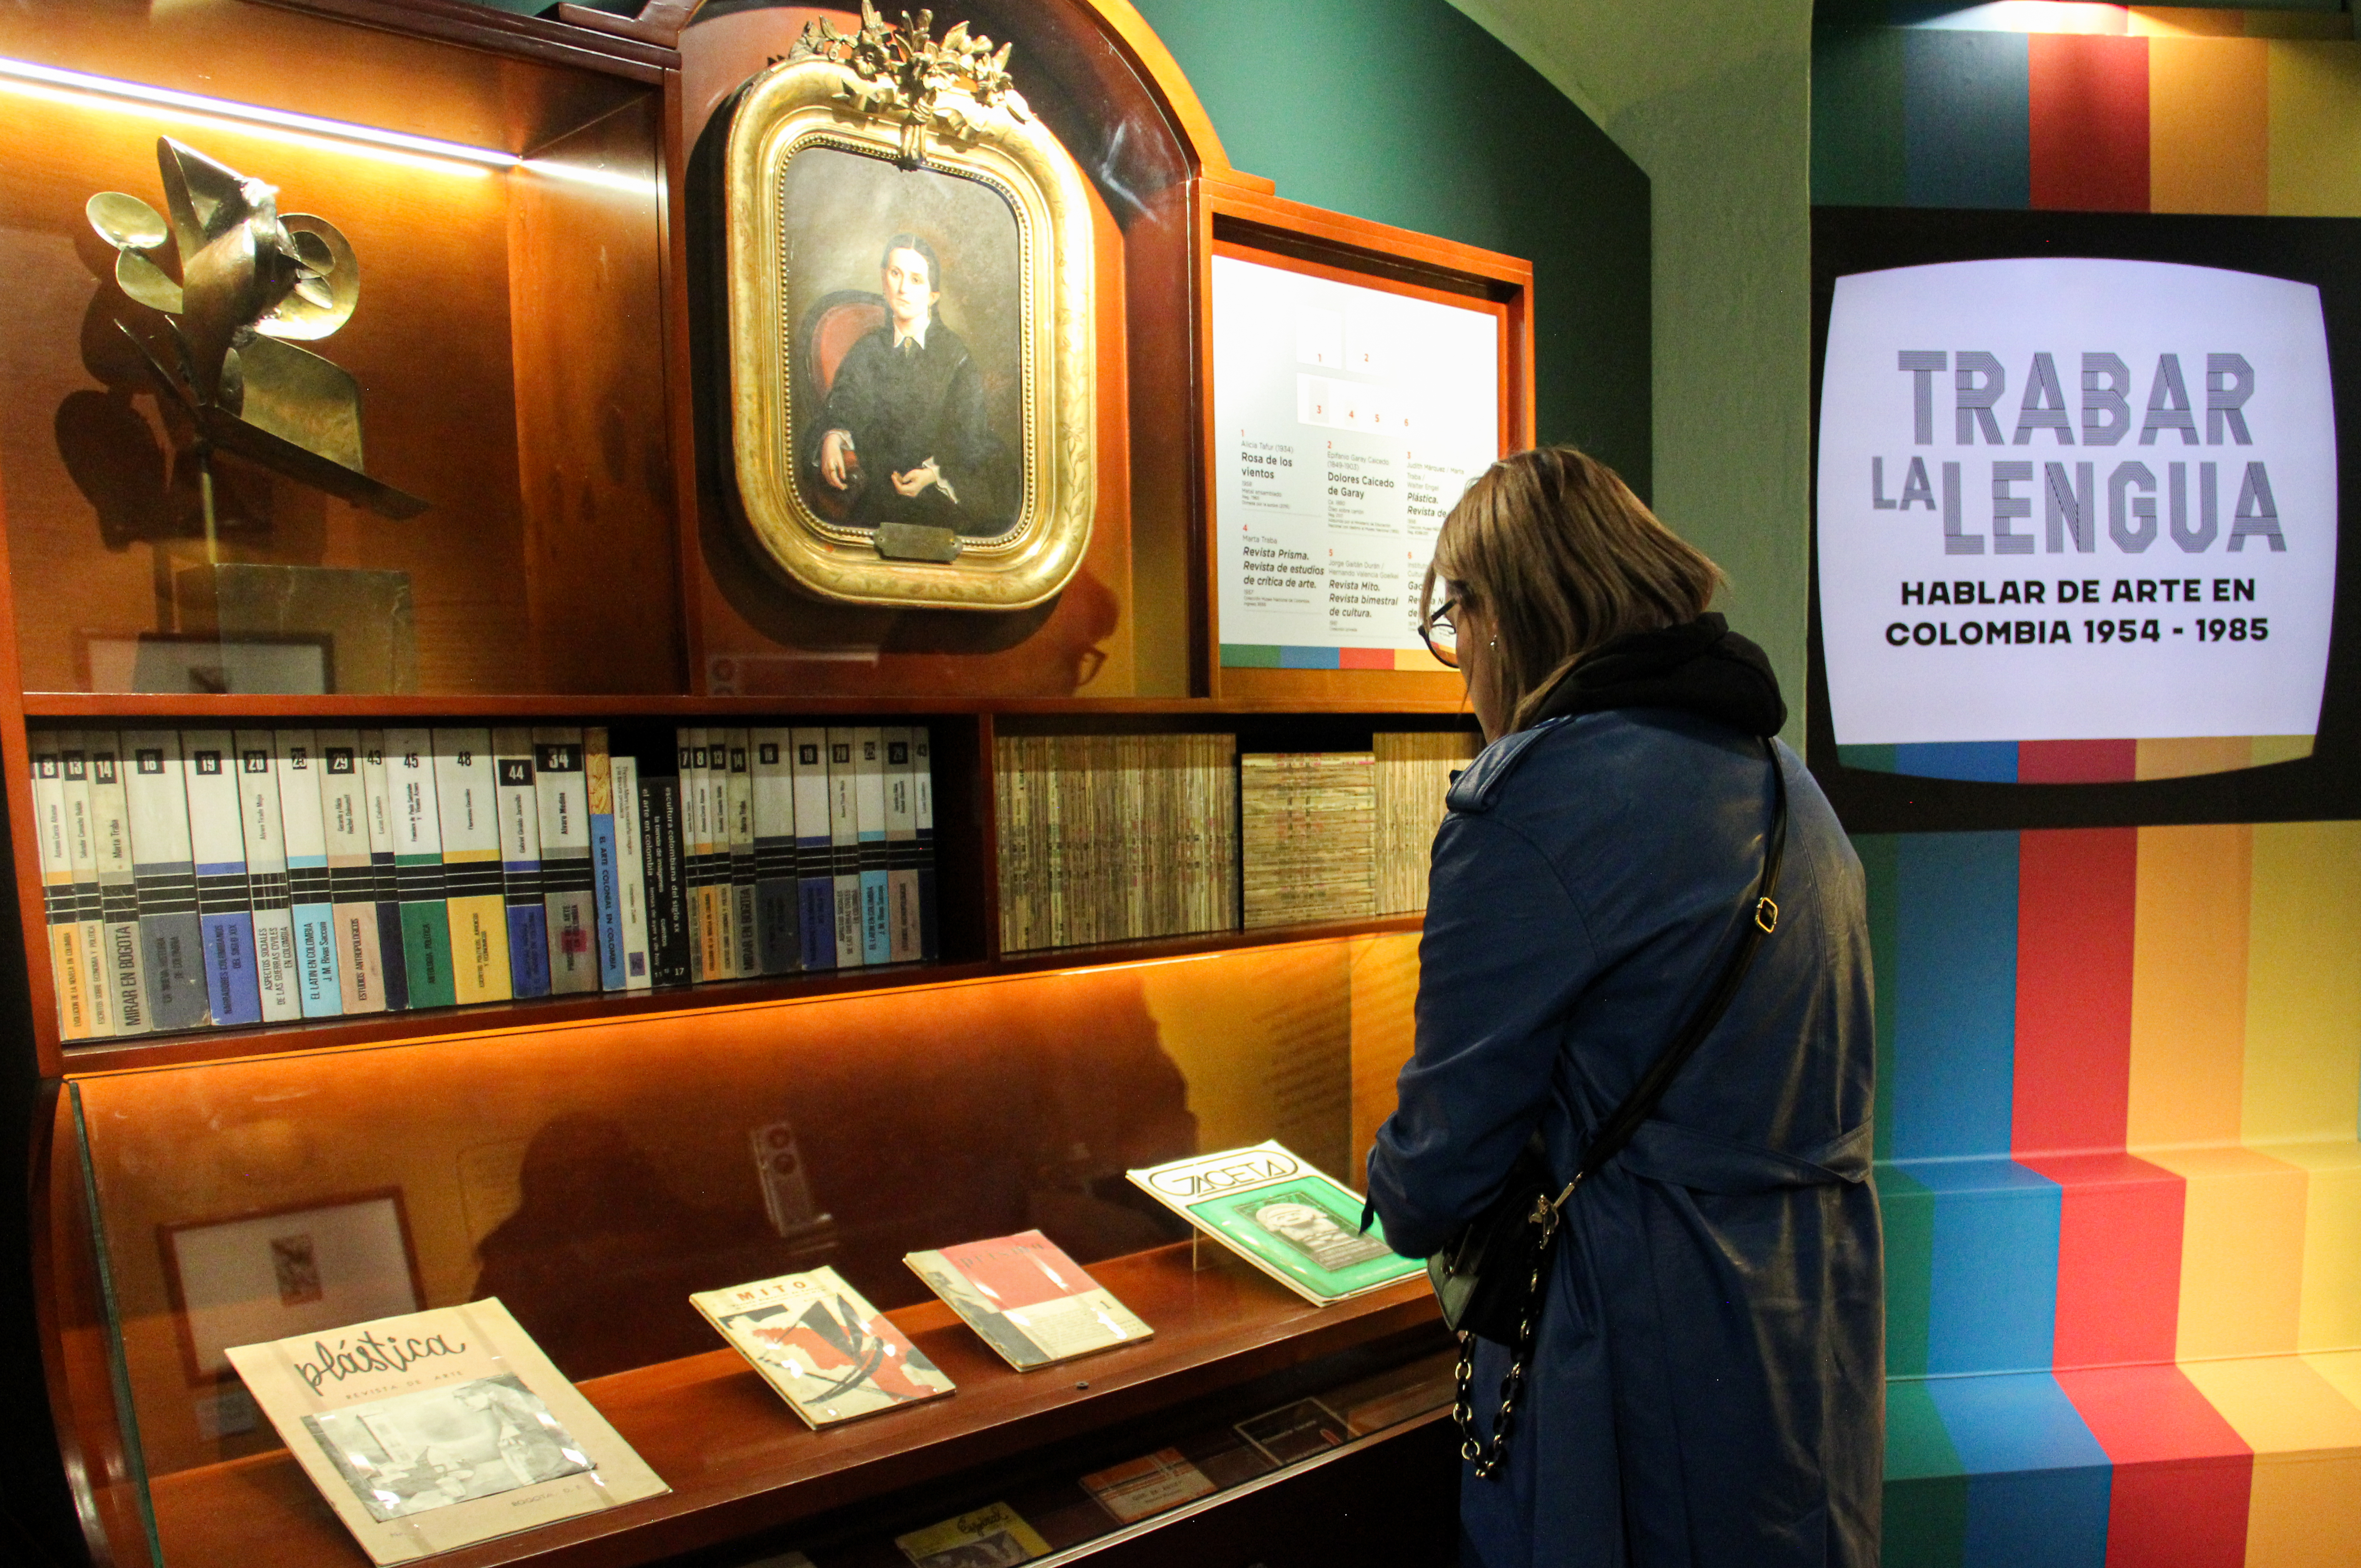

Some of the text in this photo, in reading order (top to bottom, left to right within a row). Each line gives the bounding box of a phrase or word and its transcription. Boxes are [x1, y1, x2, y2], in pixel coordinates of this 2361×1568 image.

[1364, 354, 1369, 362] 2
[1898, 351, 2254, 446] TRABAR
[1316, 405, 1321, 414] 3
[1349, 410, 1354, 418] 4
[1259, 442, 1273, 450] Tafur
[1275, 444, 1293, 453] (1934)
[1242, 452, 1292, 467] Rosa de los
[1327, 451, 1389, 466] Epifanio Garay Caicedo
[1242, 468, 1274, 479] vientos
[1328, 472, 1394, 487] Dolores Caicedo
[1872, 456, 1936, 511] LA
[1328, 486, 1364, 500] de Garay
[1407, 492, 1438, 504] Plástica.
[1407, 506, 1446, 518] Revista de
[1943, 461, 2287, 555] LENGUA
[1243, 546, 1309, 560] Revista Prisma.
[1243, 561, 1324, 575] Revista de estudios
[1329, 559, 1344, 569] Jorge
[1346, 560, 1362, 569] Gaitán
[1244, 576, 1316, 589] de crítica de arte.
[1329, 580, 1380, 592] Revista Mito.
[1329, 594, 1359, 604] Revista
[1361, 595, 1398, 606] bimestral
[1901, 578, 2255, 605] HABLAR DE ARTE EN
[1330, 607, 1372, 618] de cultura.
[1408, 609, 1417, 617] de
[1886, 620, 2072, 646] COLOMBIA
[2084, 619, 2161, 643] 1954
[2196, 617, 2269, 641] 1985
[249, 753, 264, 771] 20
[333, 753, 348, 770] 29
[367, 750, 382, 765] 43
[404, 753, 418, 768] 45
[457, 751, 471, 766] 48
[548, 748, 569, 769] 34
[697, 751, 704, 765] 8
[43, 758, 54, 776] 8
[97, 758, 112, 778] 14
[508, 765, 524, 780] 44
[642, 789, 650, 797] el
[559, 793, 567, 813] Medina
[643, 800, 651, 817] arte
[665, 787, 676, 828] escultura
[644, 821, 651, 831] en
[109, 819, 123, 858] Marta Traba
[654, 825, 663, 846] tienda
[644, 834, 654, 876] colombia
[656, 848, 663, 857] de
[668, 830, 678, 882] colombiana
[602, 870, 611, 910] COLONIAL
[670, 885, 679, 898] del
[670, 900, 680, 920] siglo
[606, 914, 613, 924] EN
[269, 927, 281, 951] CIVILES
[660, 919, 668, 947] cuentos
[280, 926, 292, 968] EN COLOMBIA
[320, 947, 330, 964] Rivas
[607, 927, 616, 970] COLOMBIA
[258, 927, 273, 991] ASPECTOS SOCIALES
[271, 953, 283, 981] GUERRAS
[304, 922, 320, 1000] EL LATIN EN COLOMBIA
[114, 926, 141, 1026] MIRAR EN BOGOTA
[675, 968, 684, 976] 17
[274, 983, 285, 995] LAS
[356, 972, 367, 1001] ESTUDIOS
[1171, 1158, 1287, 1198] GACETA
[960, 1244, 1044, 1268] prisma
[737, 1281, 806, 1301] MITO
[1099, 1301, 1112, 1310] 1
[294, 1331, 466, 1397] plástica
[346, 1386, 398, 1399] REVISTA
[434, 1371, 463, 1380] ARTE
